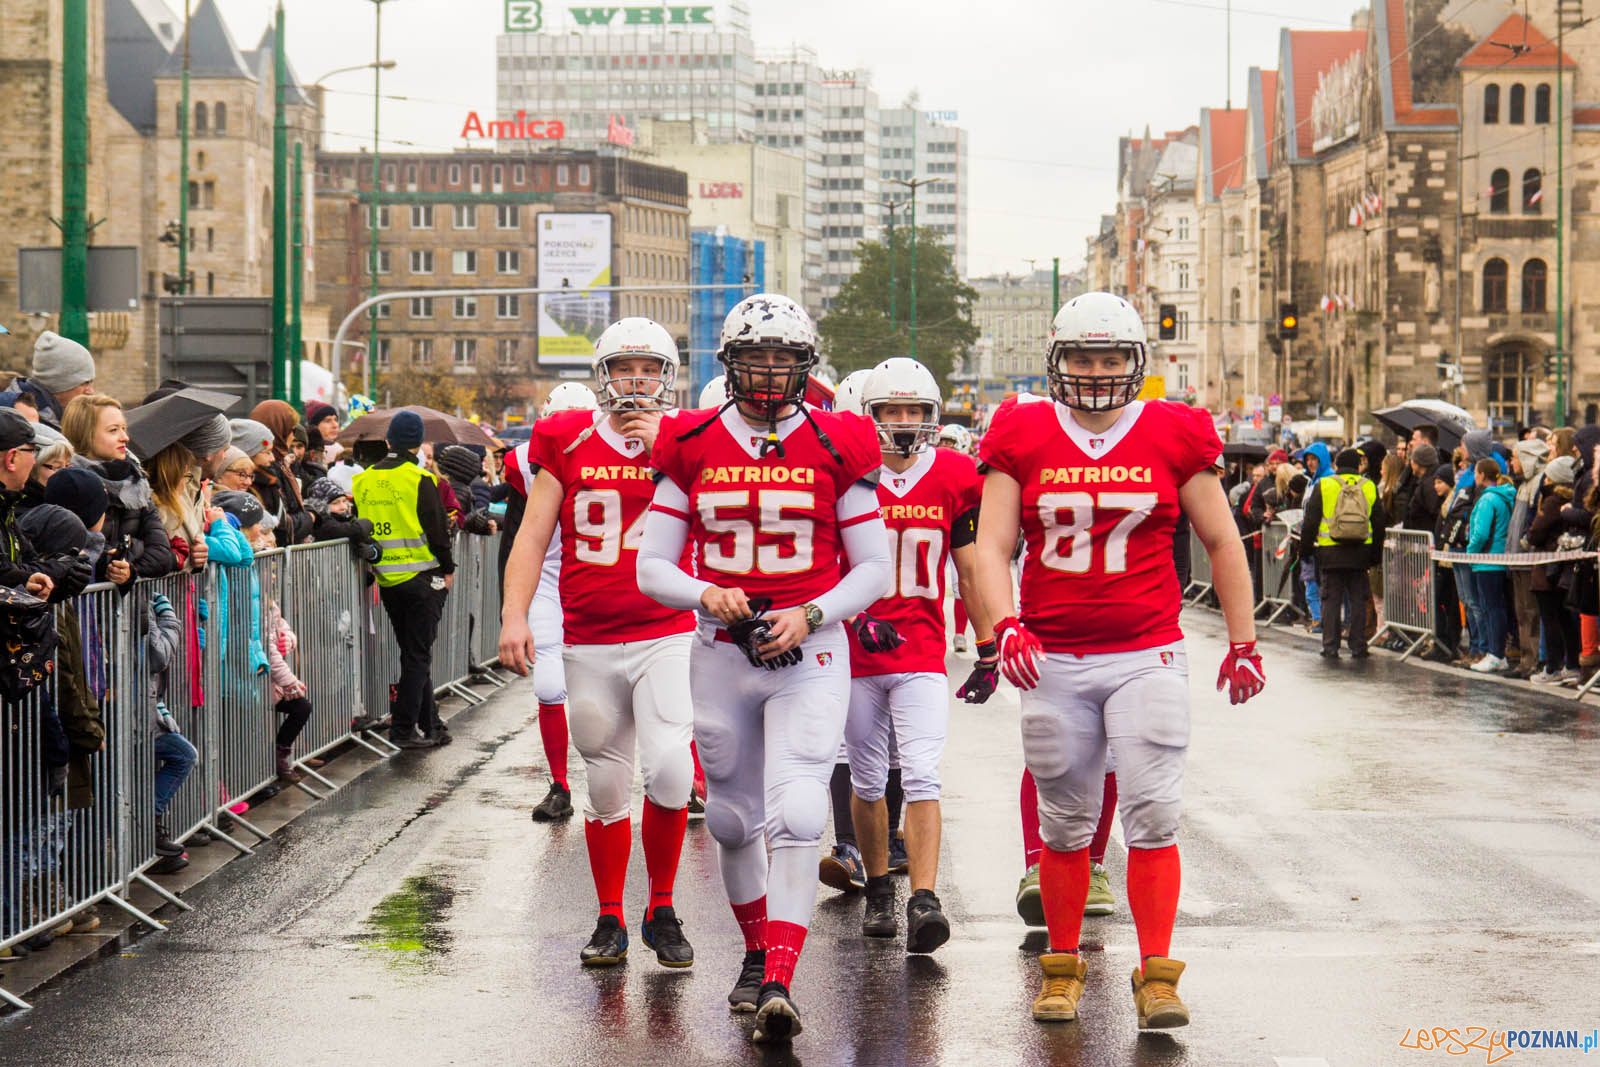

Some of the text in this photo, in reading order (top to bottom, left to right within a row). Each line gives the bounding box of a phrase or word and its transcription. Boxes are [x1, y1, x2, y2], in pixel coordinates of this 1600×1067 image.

[568, 7, 713, 25] WBK
[461, 110, 565, 139] Amica
[701, 466, 815, 485] PATRIOCI
[1040, 466, 1152, 485] PATRIOCI
[697, 489, 815, 574] 55
[1037, 492, 1158, 574] 87
[878, 527, 944, 600] 0
